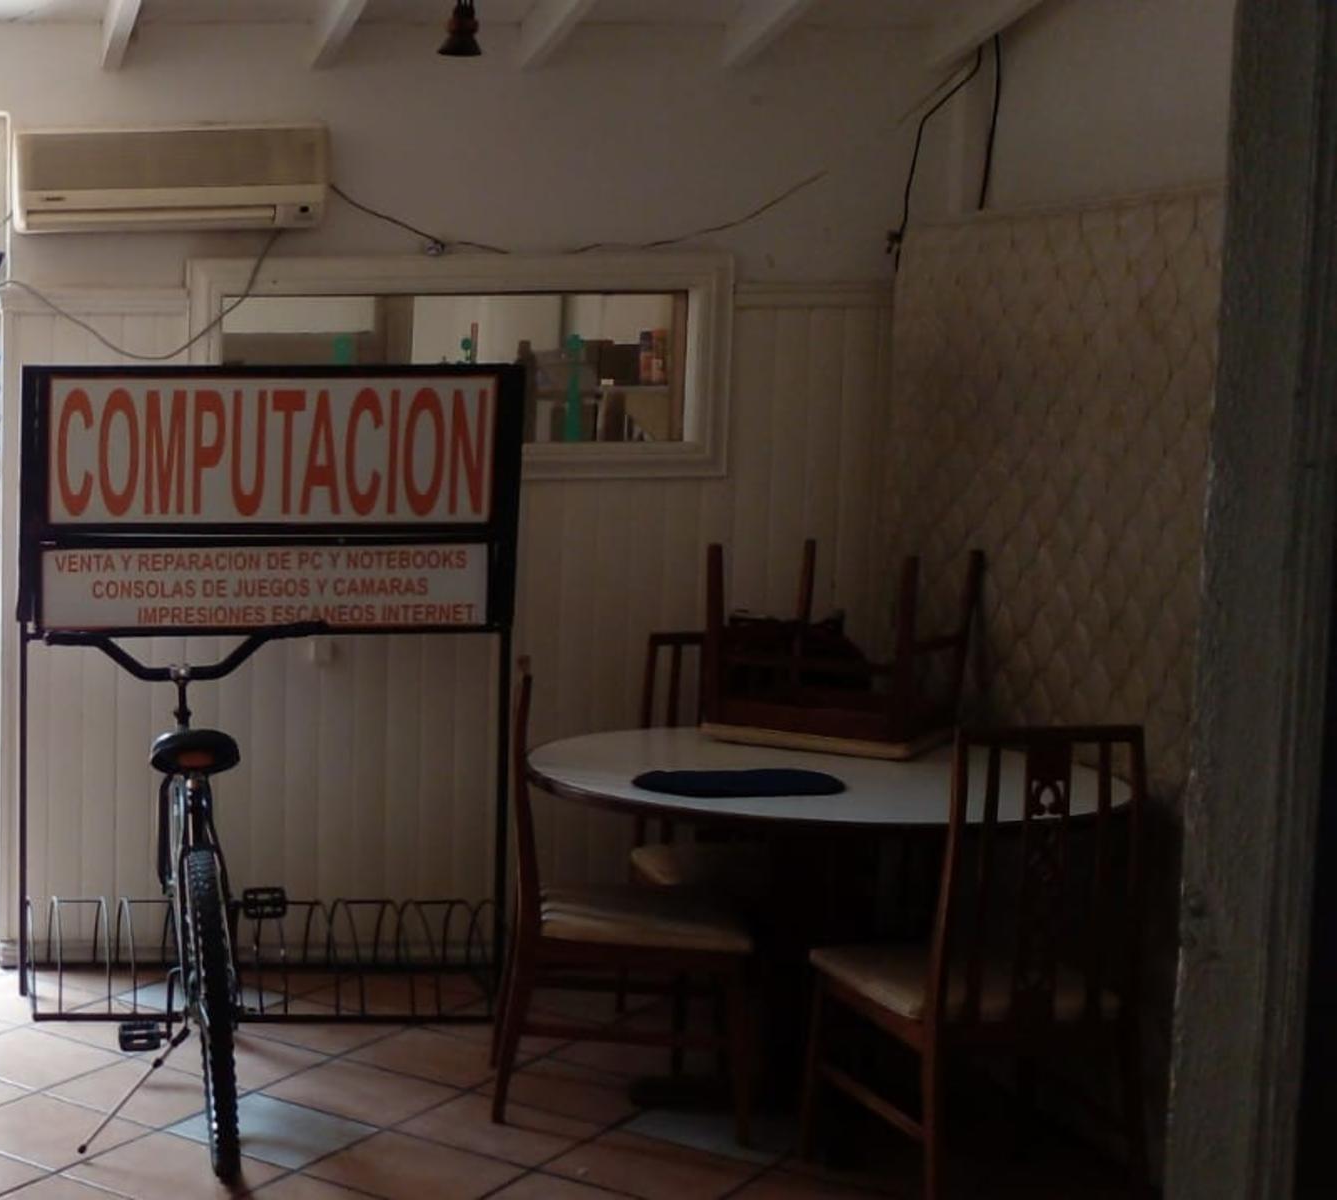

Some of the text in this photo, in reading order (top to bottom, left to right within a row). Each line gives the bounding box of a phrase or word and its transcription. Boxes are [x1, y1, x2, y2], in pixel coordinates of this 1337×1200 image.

[57, 387, 488, 517] COMPUTACION
[54, 550, 468, 573] VENTA Y REPARACION DE PC Y NOTEBOOKS
[91, 577, 429, 599] CONSOLAS DE JUEGOS Y CAMARAS
[137, 603, 475, 625] IMPRESIONES ESCANEOS INTERNET
